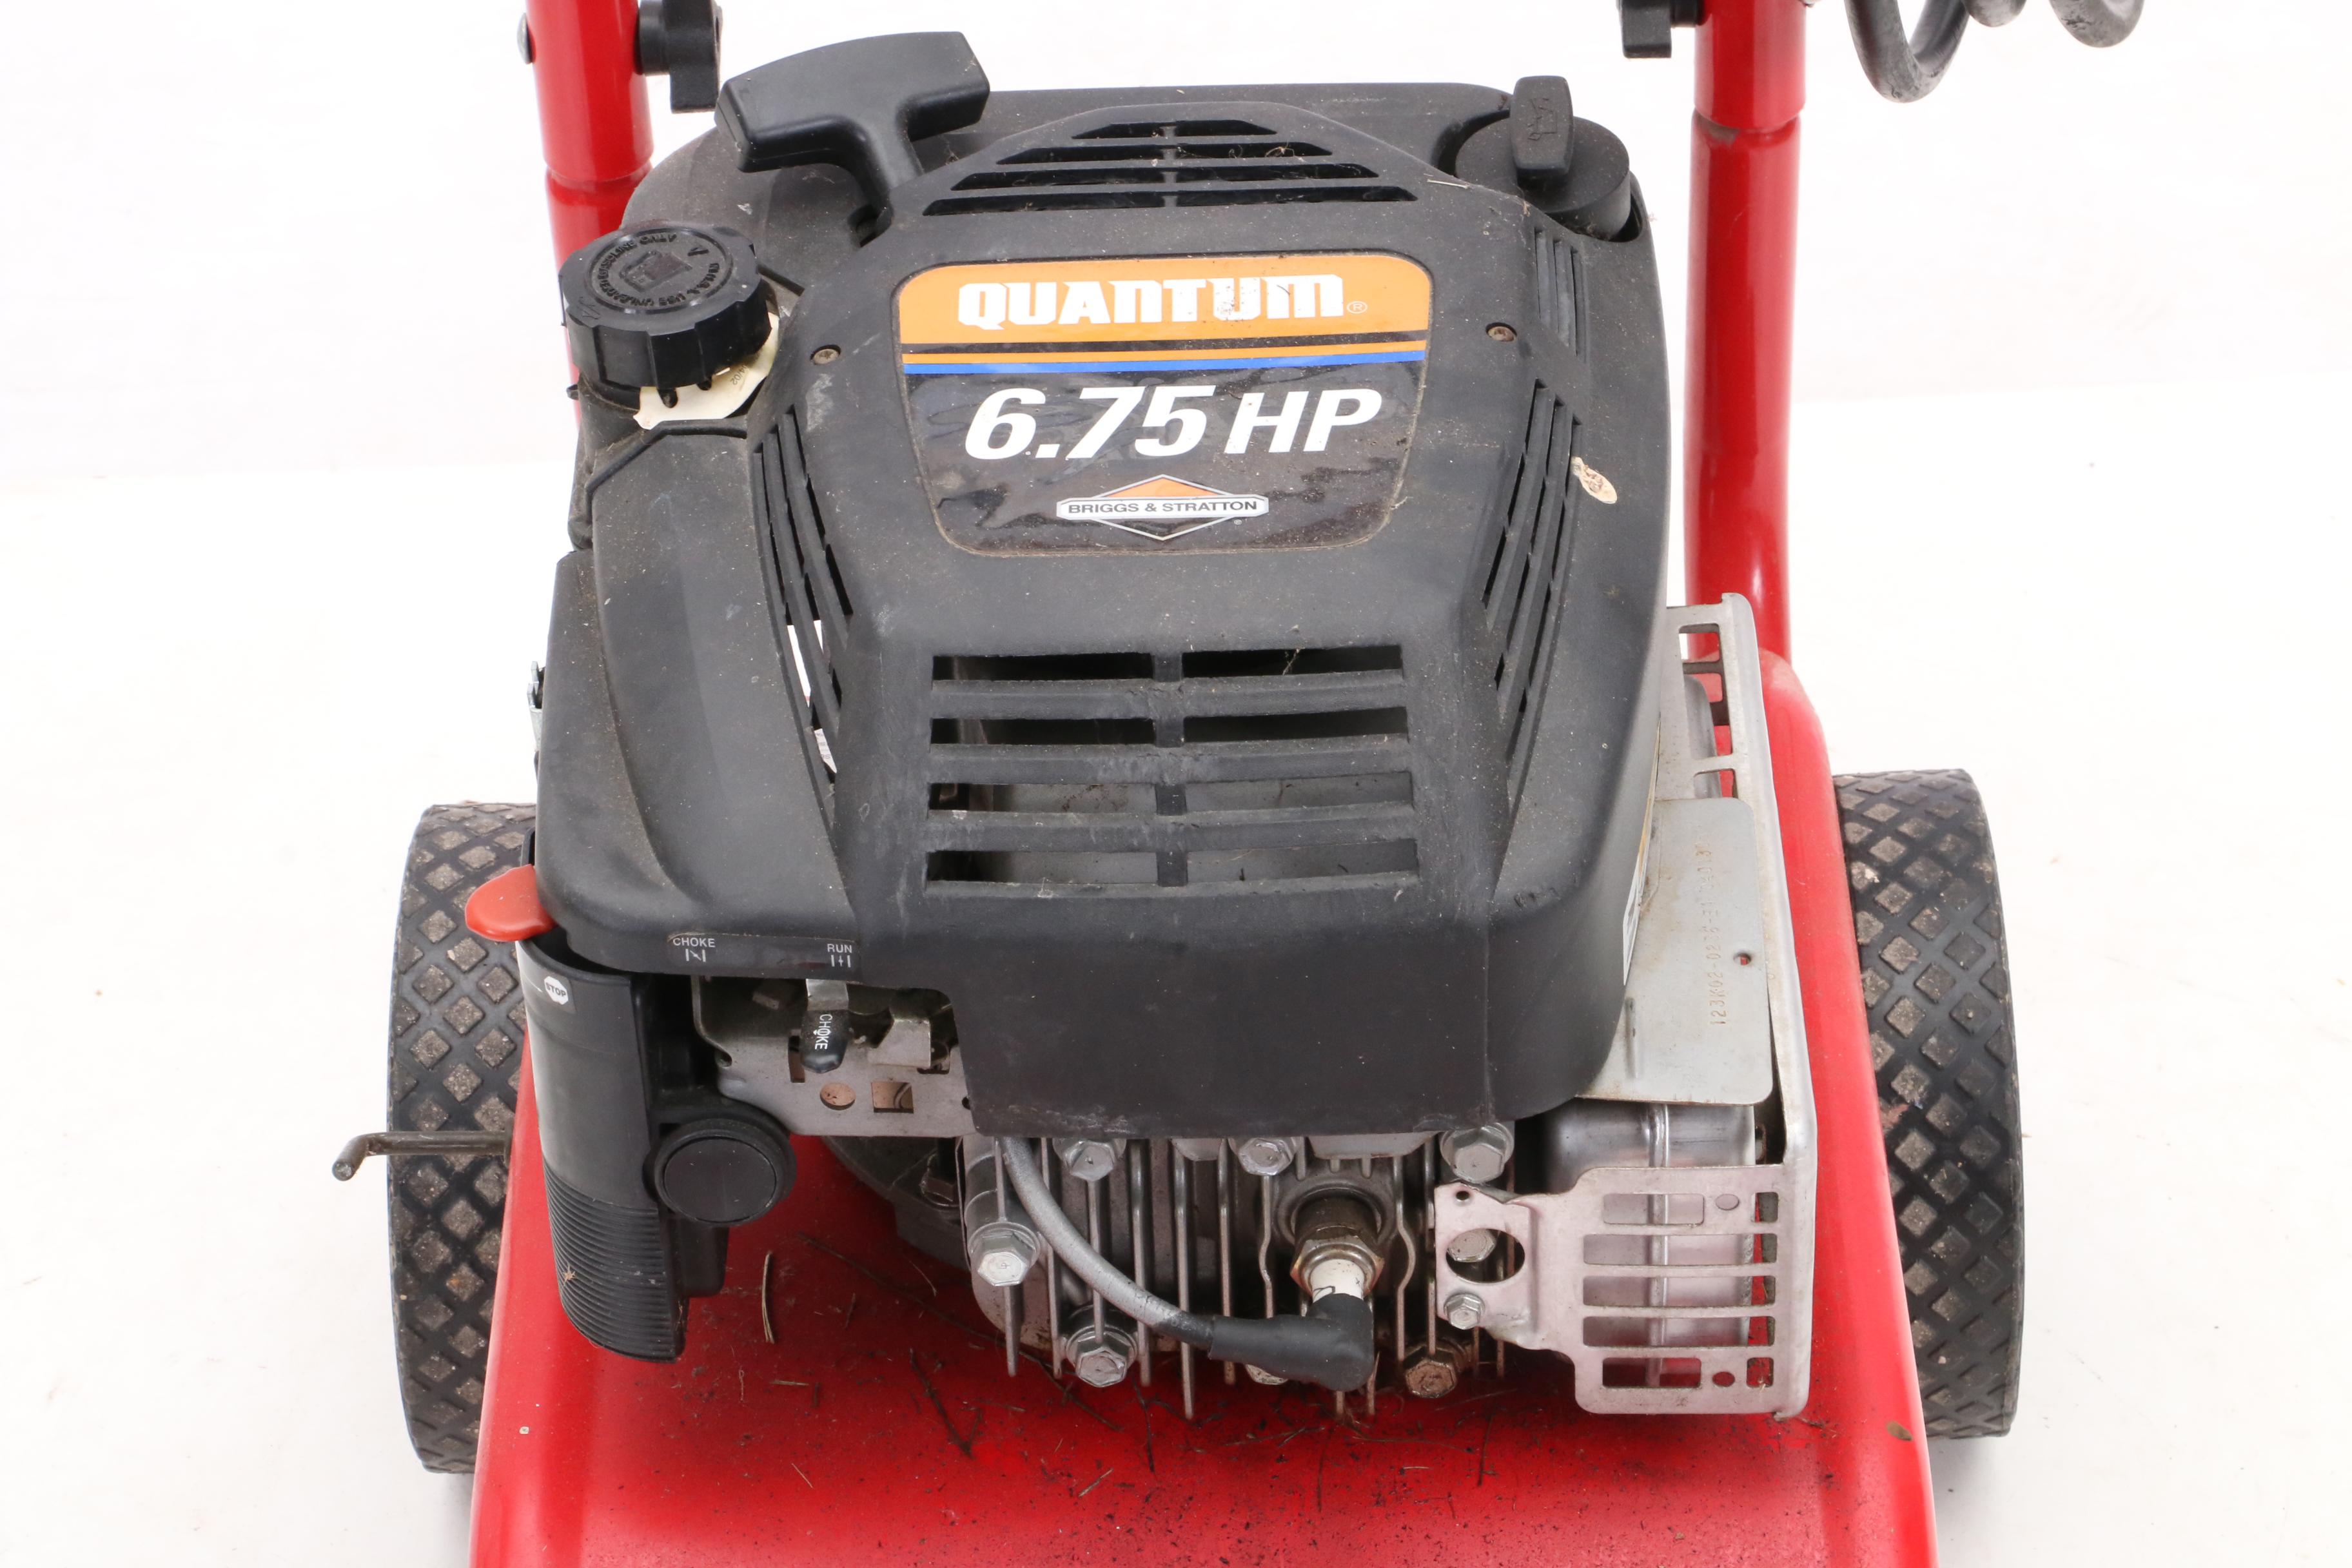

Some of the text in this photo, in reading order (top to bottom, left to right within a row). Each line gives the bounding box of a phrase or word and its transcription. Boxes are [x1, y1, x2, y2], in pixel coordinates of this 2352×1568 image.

[957, 273, 1344, 330] QUANTUM
[965, 385, 1382, 460] 6.75 HP
[1068, 500, 1257, 515] BRIGGS & STRATTON
[672, 937, 716, 948] CHOKE
[827, 943, 853, 954] RUN
[545, 982, 567, 997] STOP
[814, 1014, 832, 1050] CHOKE
